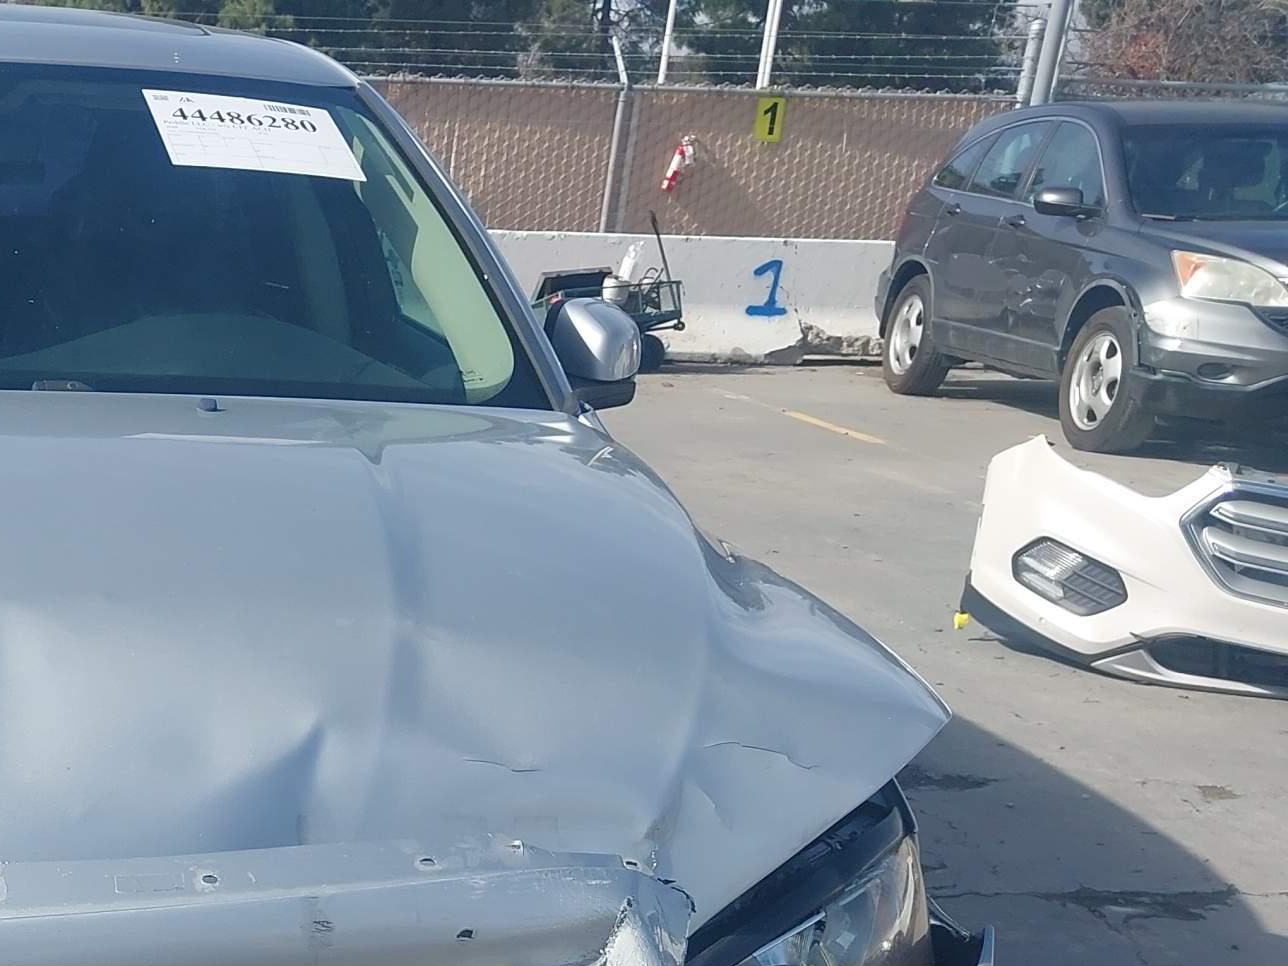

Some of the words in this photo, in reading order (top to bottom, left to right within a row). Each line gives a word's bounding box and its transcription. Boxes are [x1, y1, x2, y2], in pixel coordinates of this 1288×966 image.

[172, 107, 318, 133] 44486280
[763, 101, 779, 135] 1
[745, 259, 788, 317] 1
